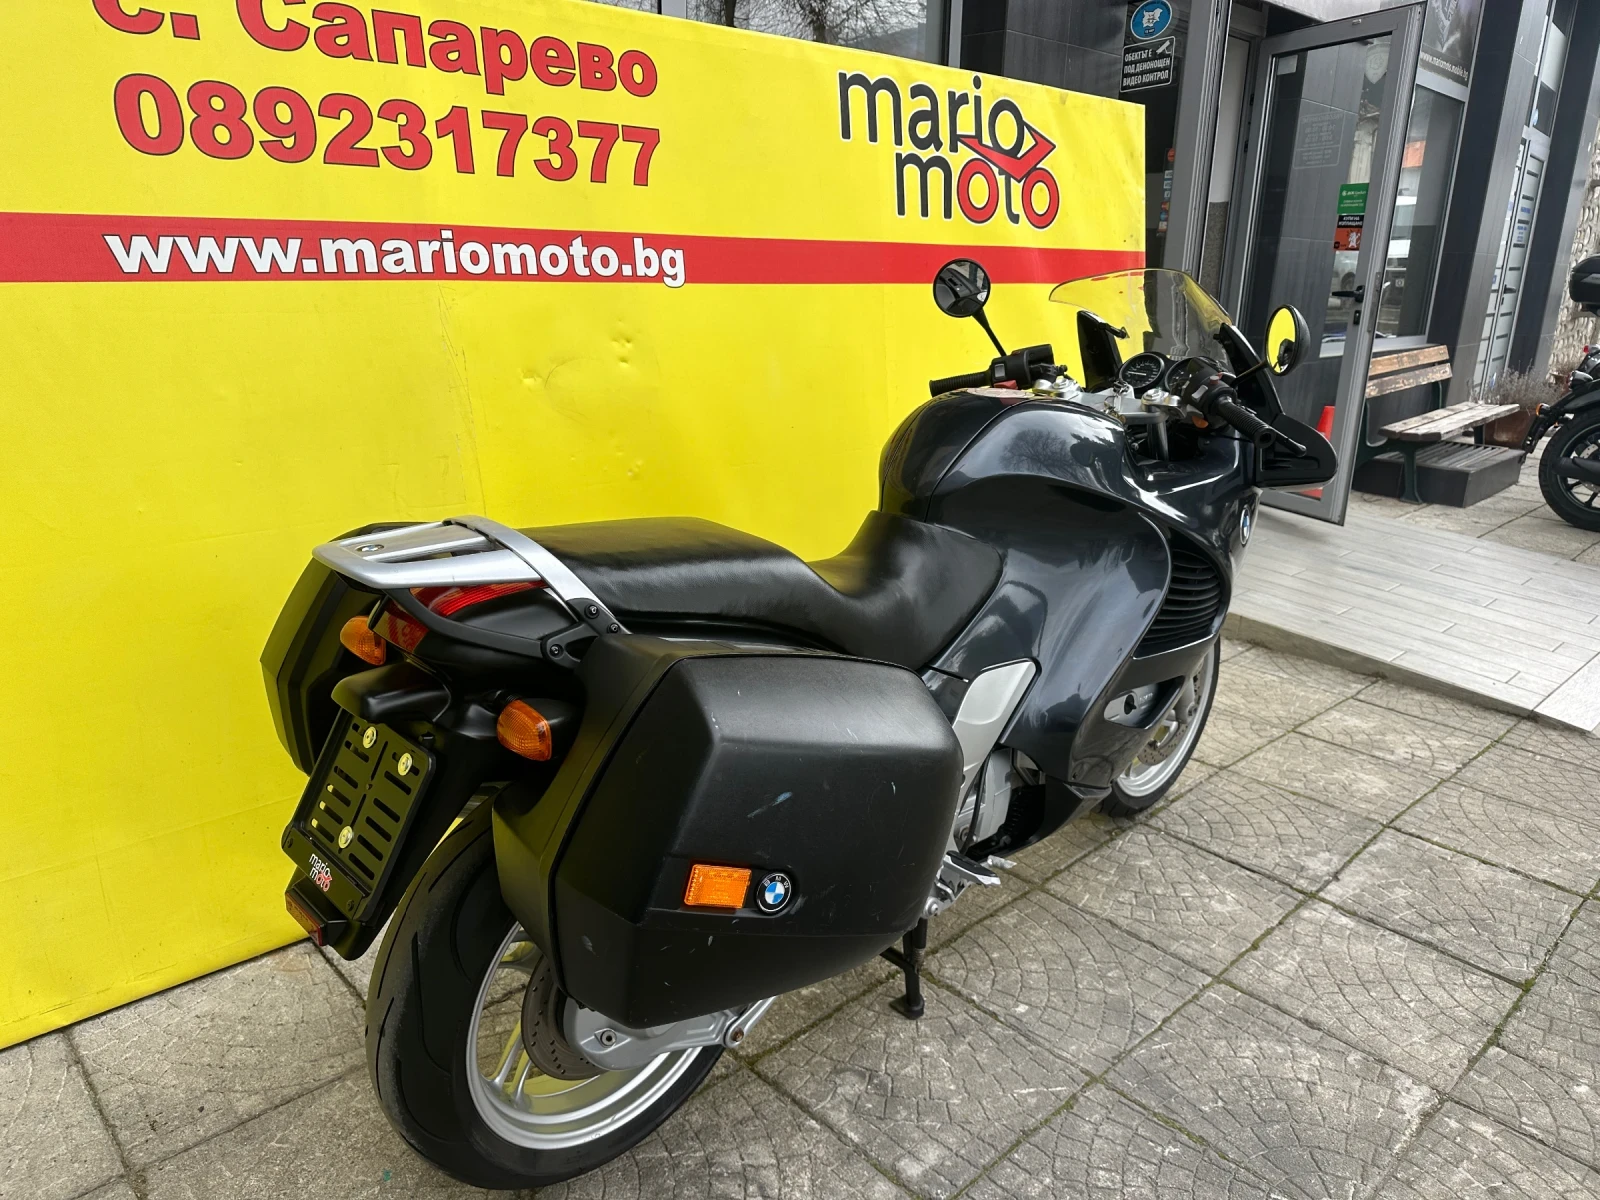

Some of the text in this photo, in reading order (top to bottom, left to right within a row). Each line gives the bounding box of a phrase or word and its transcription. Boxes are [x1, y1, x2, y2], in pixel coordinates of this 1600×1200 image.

[235, 0, 658, 98] Сапарево
[1123, 58, 1171, 74] ПОД ДЕНОНОЩЕН
[1125, 50, 1148, 62] ОБЕКТЪТ
[1122, 70, 1169, 87] ВИДЕО КОНТРОЛ
[113, 73, 661, 187] 0892317377
[837, 71, 1025, 158] mario
[894, 152, 1060, 230] moto
[103, 229, 687, 289] www.mariomoto.bg
[309, 853, 331, 877] mario
[309, 867, 331, 892] moto
